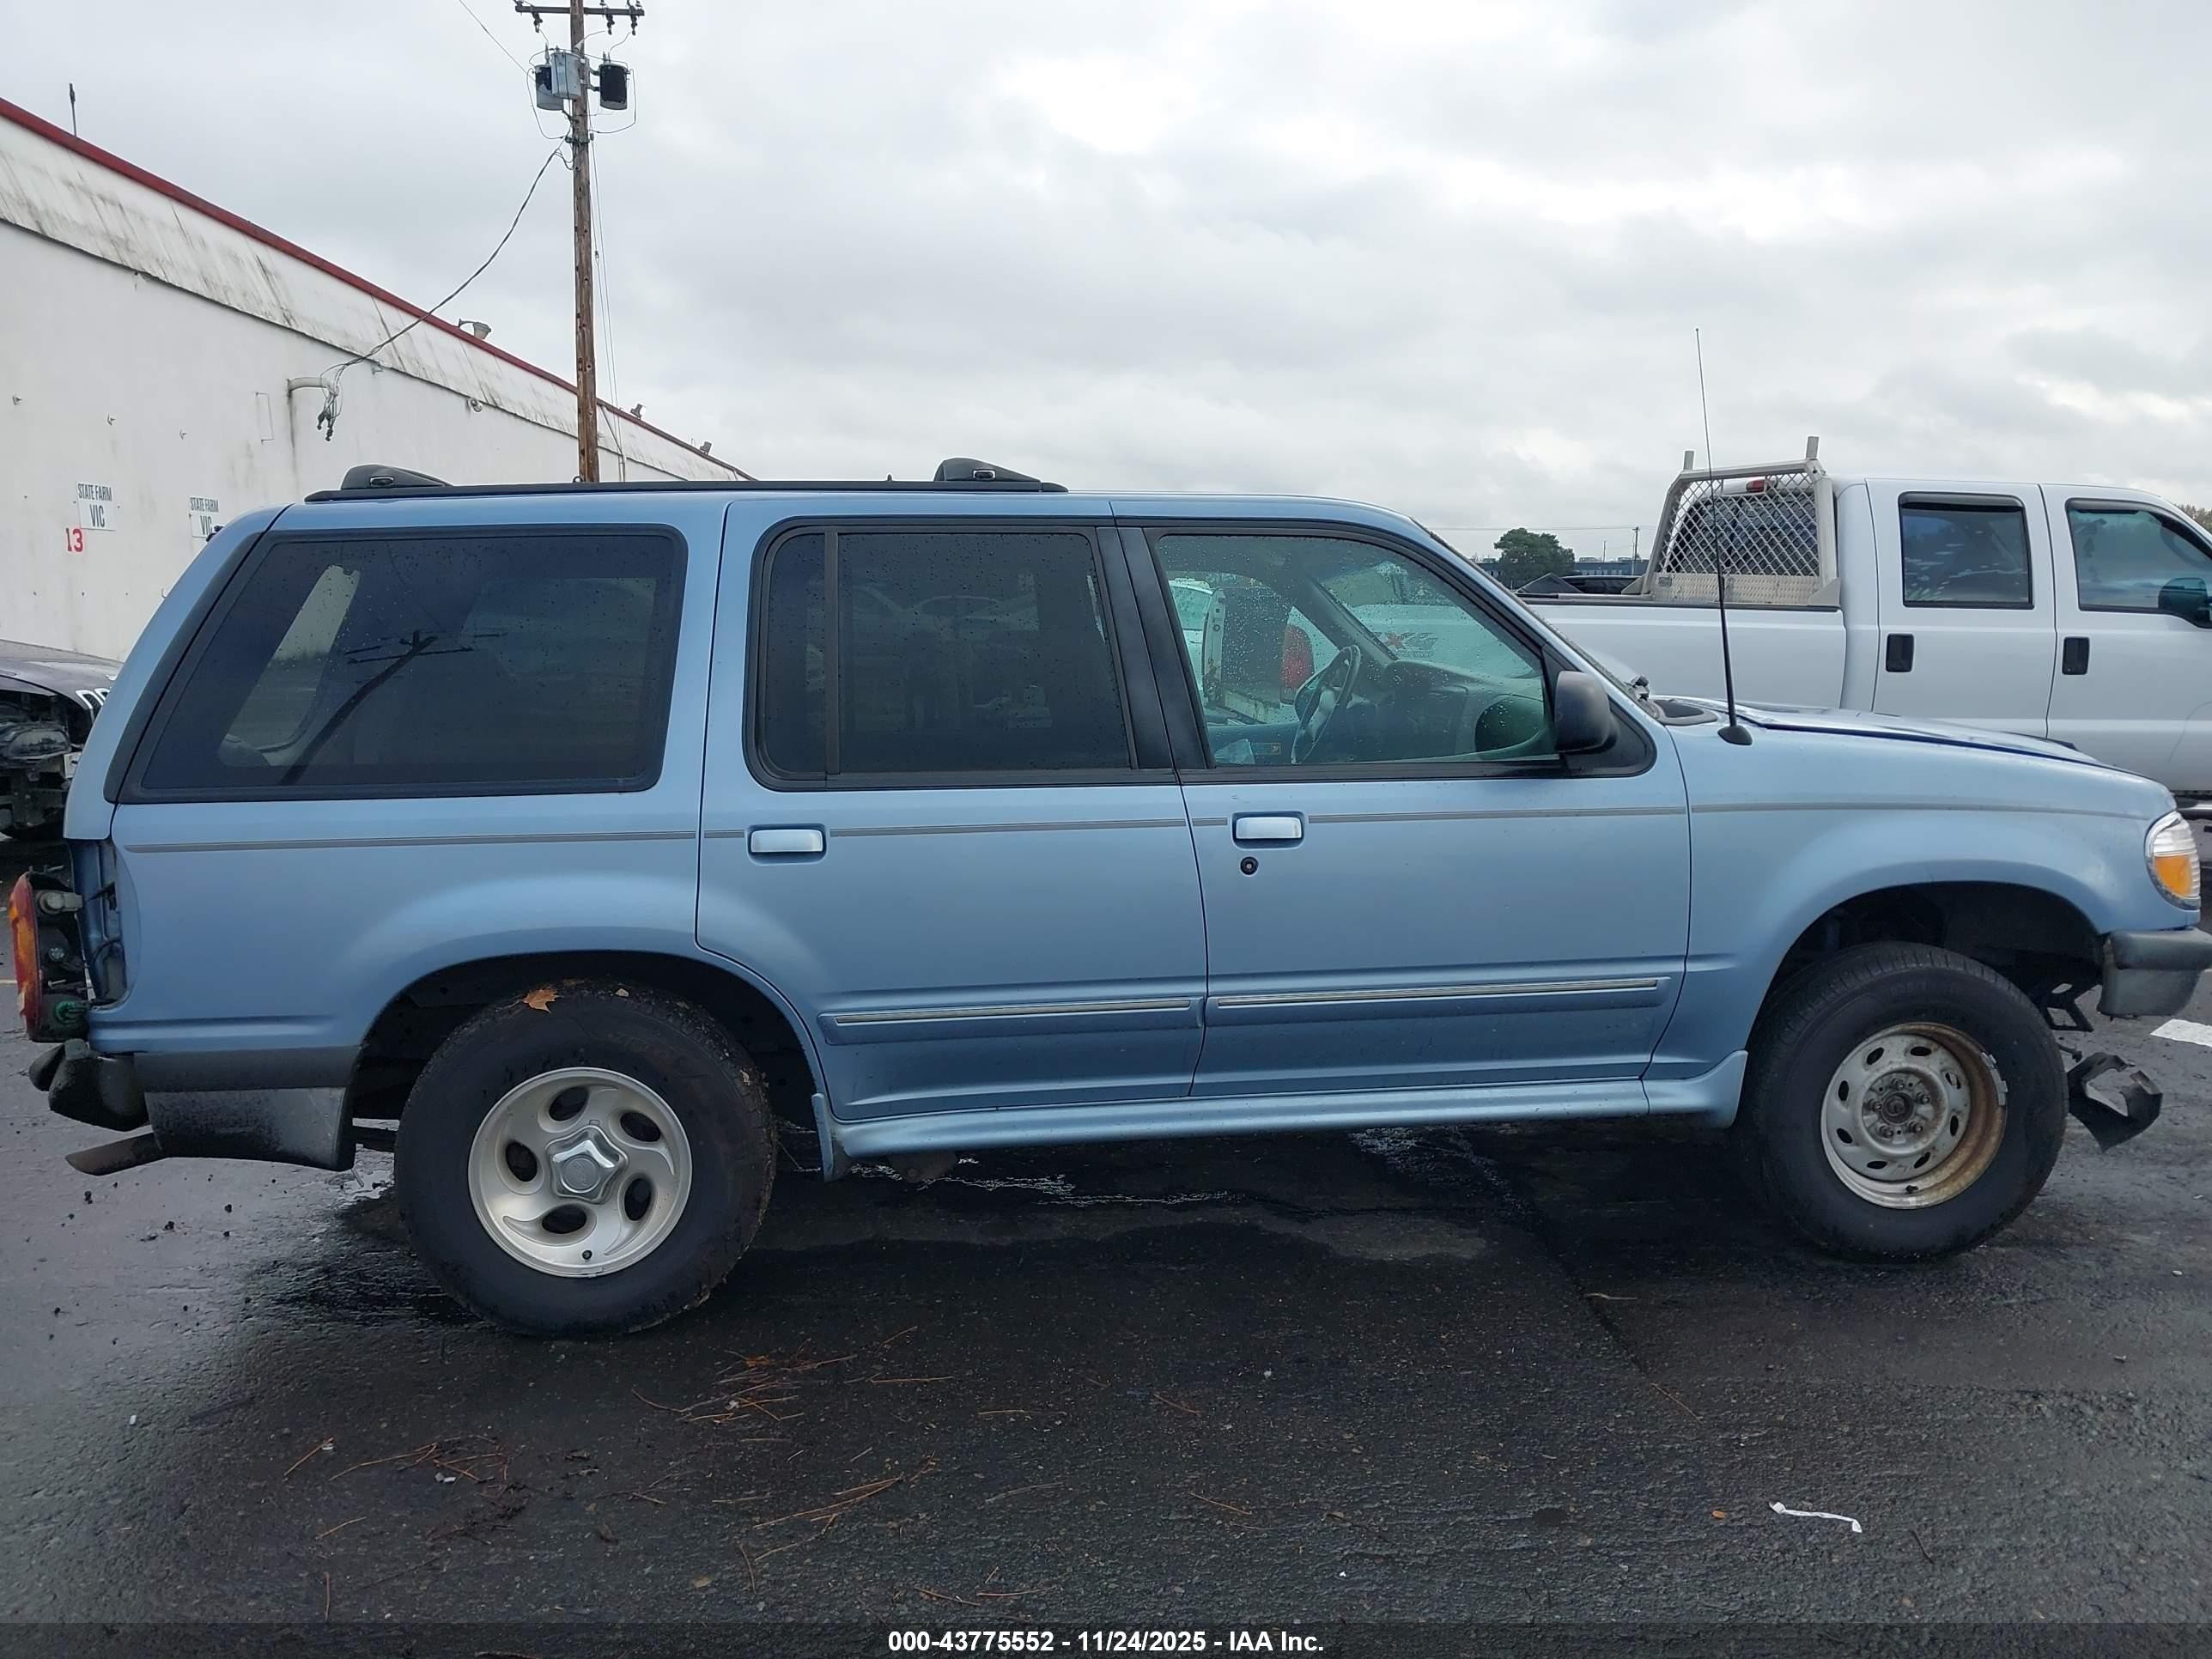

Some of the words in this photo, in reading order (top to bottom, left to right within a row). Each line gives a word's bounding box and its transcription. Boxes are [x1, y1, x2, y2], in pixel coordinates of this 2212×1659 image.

[78, 483, 94, 500] STATE
[94, 485, 112, 501] FARM
[190, 497, 204, 511] STATE
[89, 504, 105, 527] VIC
[200, 515, 213, 535] VIC
[65, 527, 83, 552] 13
